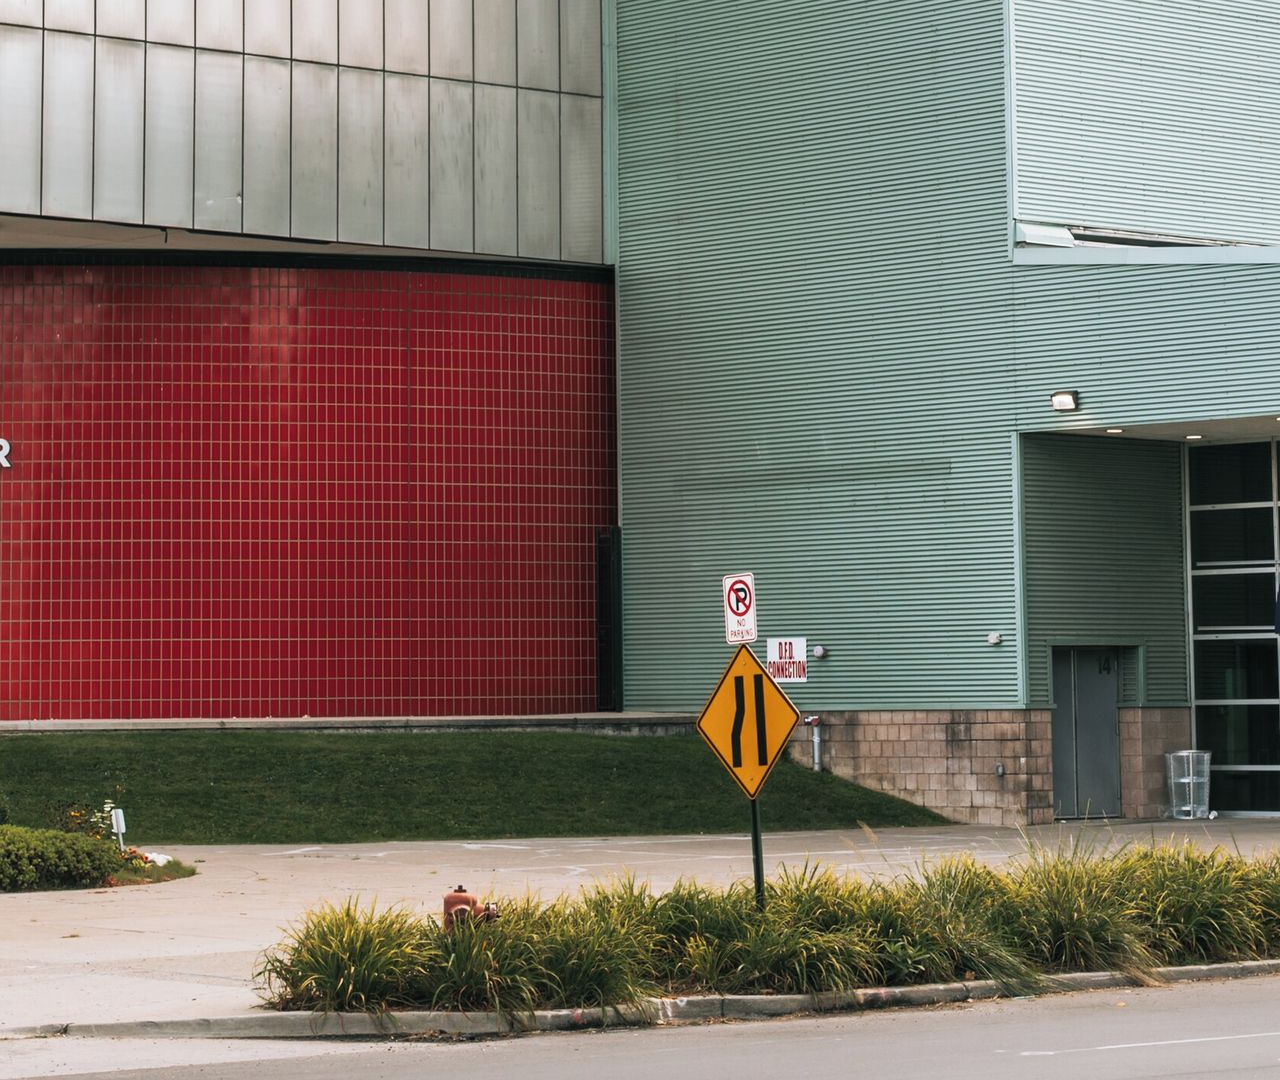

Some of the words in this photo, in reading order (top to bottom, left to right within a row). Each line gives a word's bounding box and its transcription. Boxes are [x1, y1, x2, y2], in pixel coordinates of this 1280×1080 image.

[736, 618, 746, 627] NO
[730, 628, 753, 639] PARKING
[778, 641, 795, 660] D.F.D.
[768, 661, 807, 679] CONNECTION
